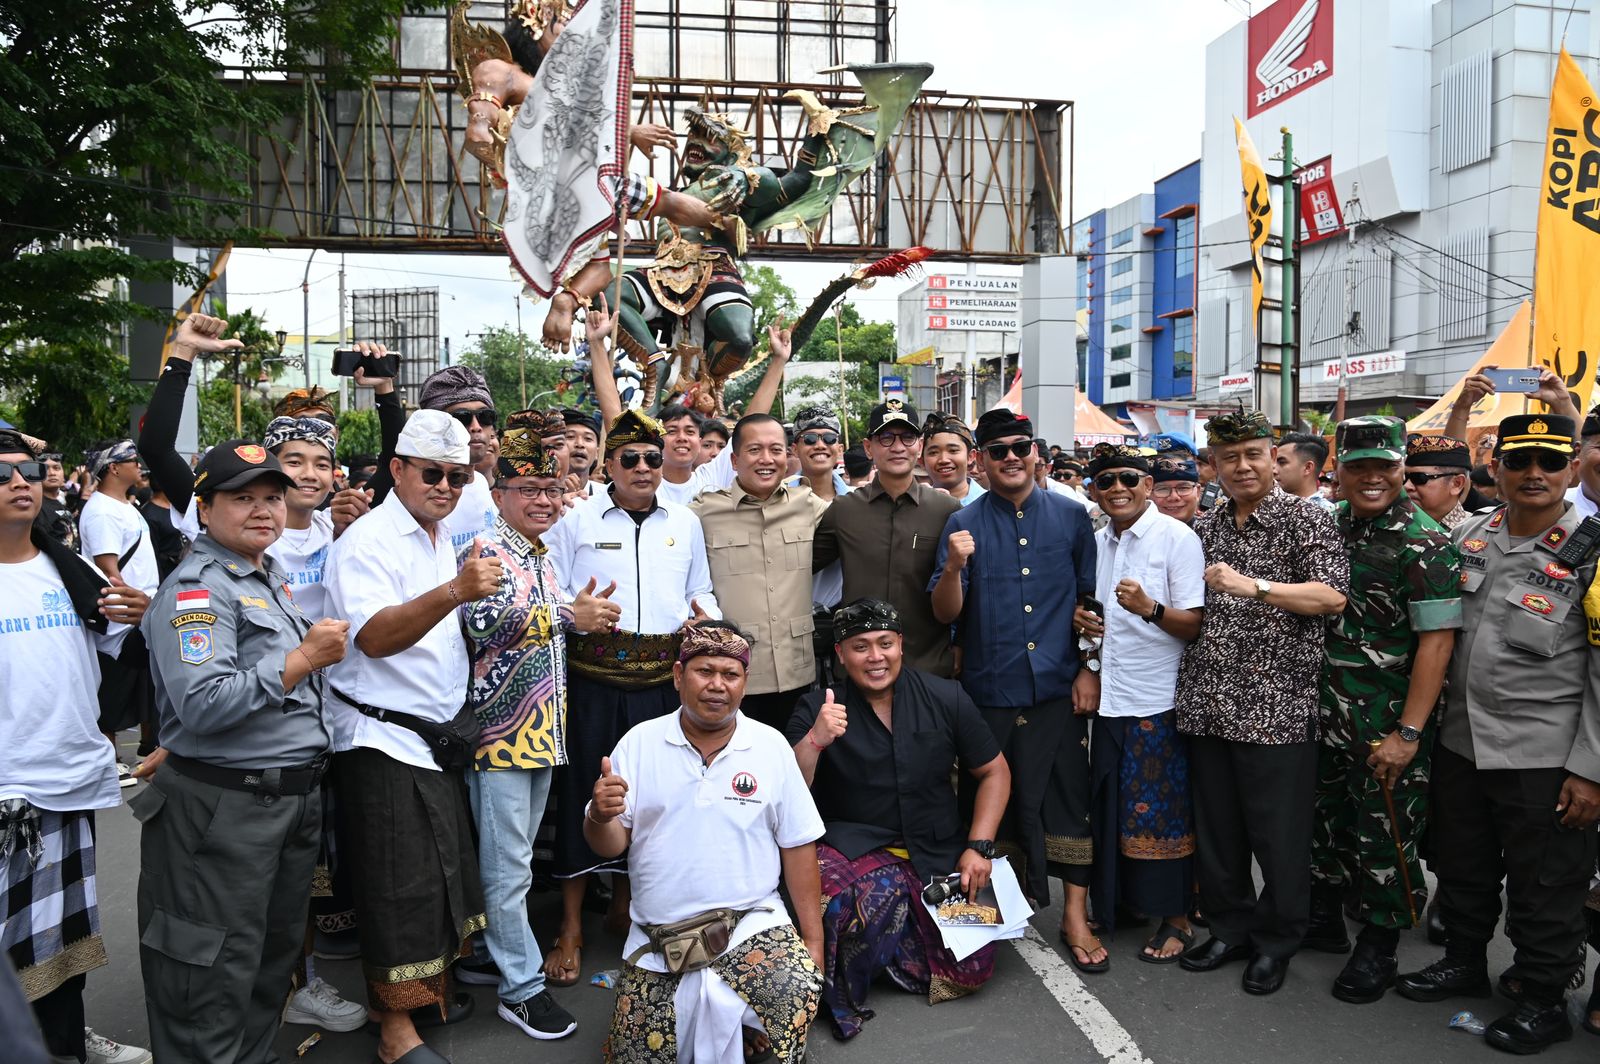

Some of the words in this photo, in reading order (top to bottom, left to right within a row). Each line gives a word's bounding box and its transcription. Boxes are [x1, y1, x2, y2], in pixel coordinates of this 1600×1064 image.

[1256, 59, 1329, 107] HONDA
[1294, 164, 1326, 185] TOR
[1547, 127, 1577, 210] KOPI
[949, 279, 1018, 289] PENJUALAN
[949, 299, 1017, 307] PEMELIHARAAN
[979, 320, 1016, 328] CADANG
[1222, 377, 1249, 386] HONDA
[1527, 571, 1573, 595] POLRI
